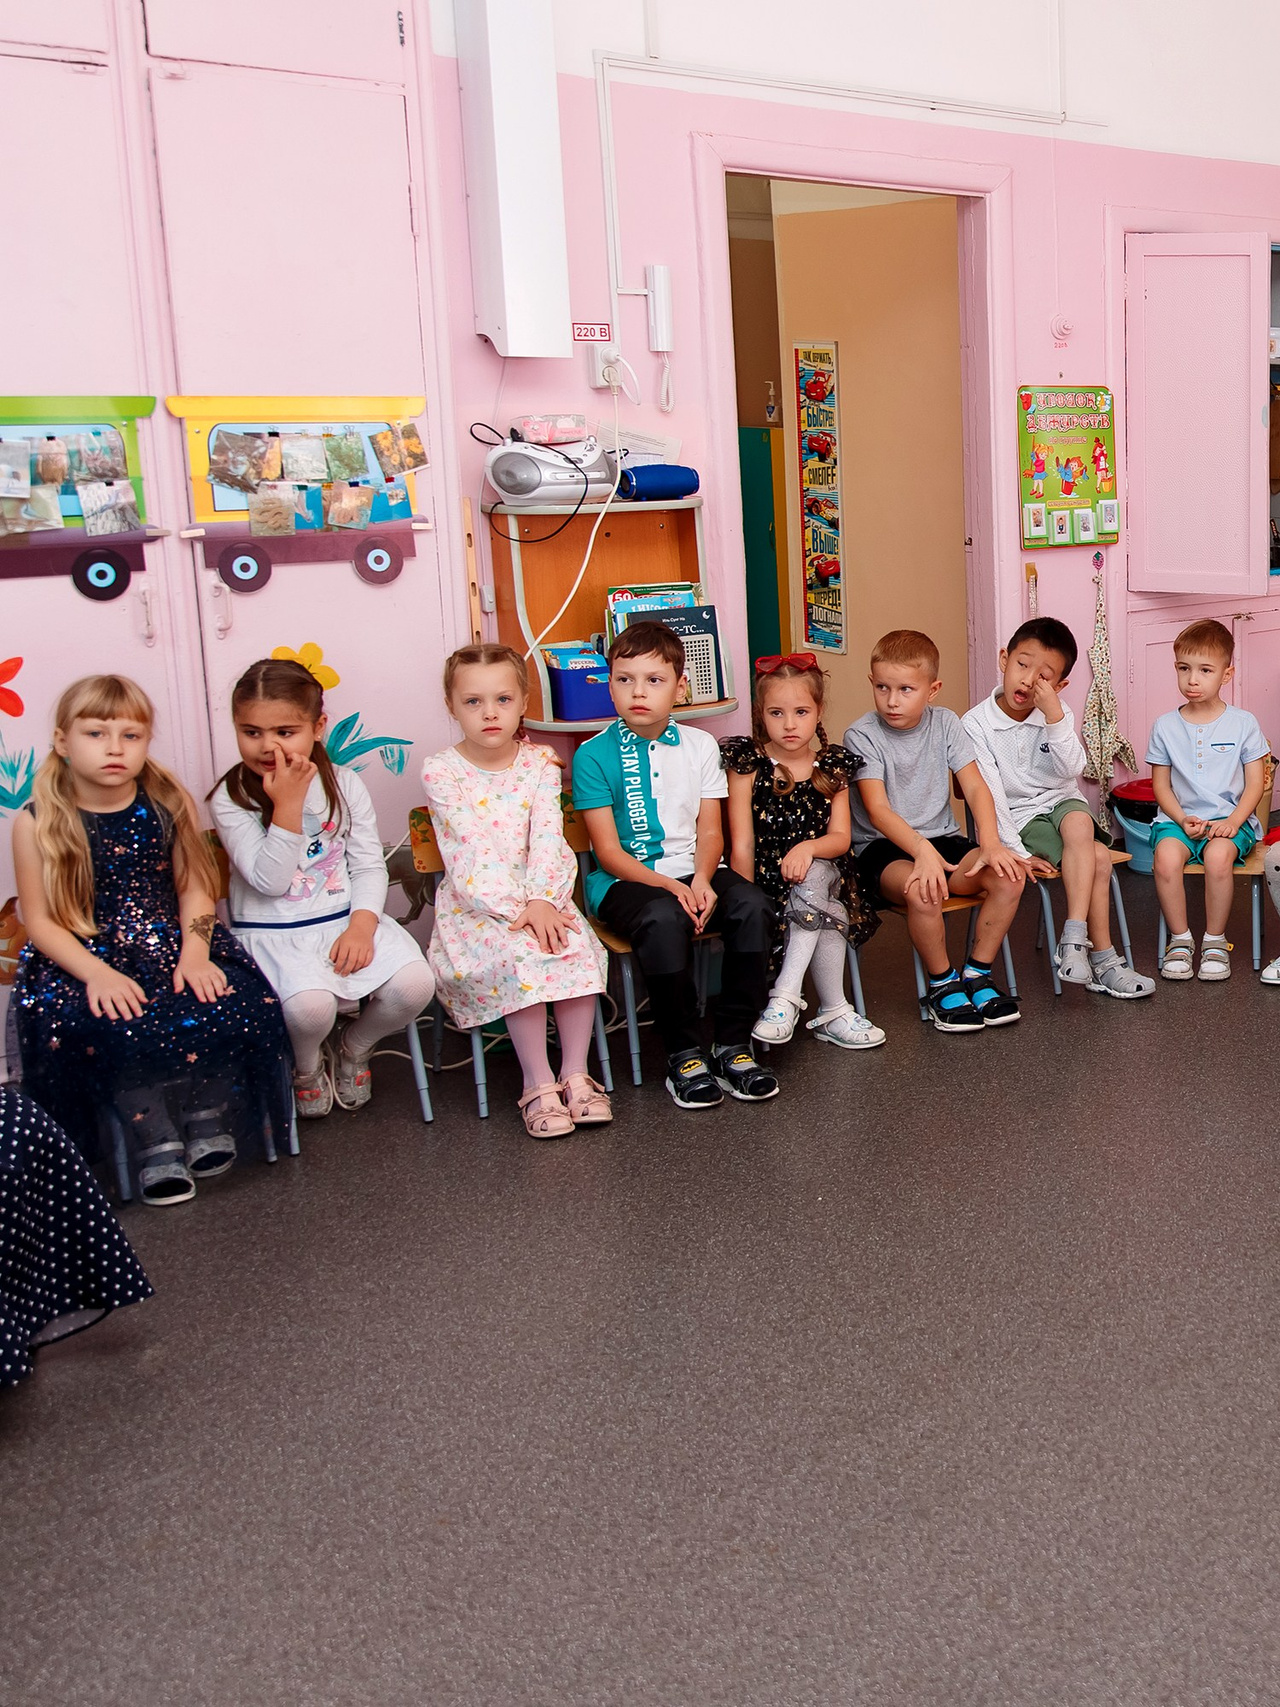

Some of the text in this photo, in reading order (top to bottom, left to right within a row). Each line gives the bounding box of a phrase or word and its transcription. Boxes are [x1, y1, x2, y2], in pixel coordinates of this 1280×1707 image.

[576, 327, 608, 338] 220 В
[1025, 413, 1111, 434] ДЕЖУРСТВ
[614, 592, 632, 601] 50
[620, 744, 640, 774] STAY
[624, 777, 649, 832] PLUGGED
